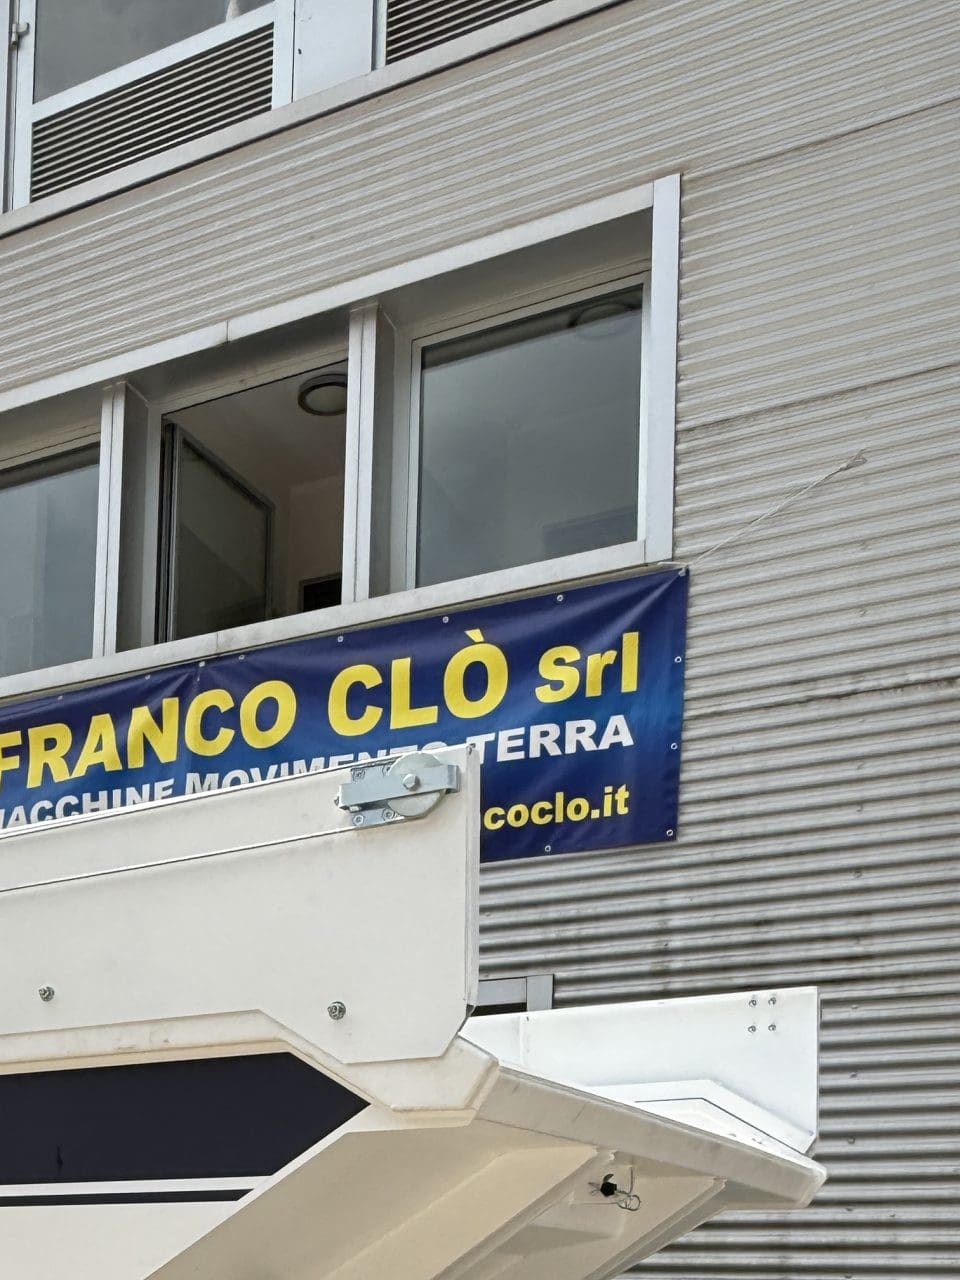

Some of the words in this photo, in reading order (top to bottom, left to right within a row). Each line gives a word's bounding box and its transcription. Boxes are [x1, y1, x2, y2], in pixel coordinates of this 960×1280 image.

[328, 630, 508, 734] CLÒ
[535, 632, 639, 704] Srl
[466, 714, 634, 765] TERRA
[483, 783, 630, 830] coclo.it
